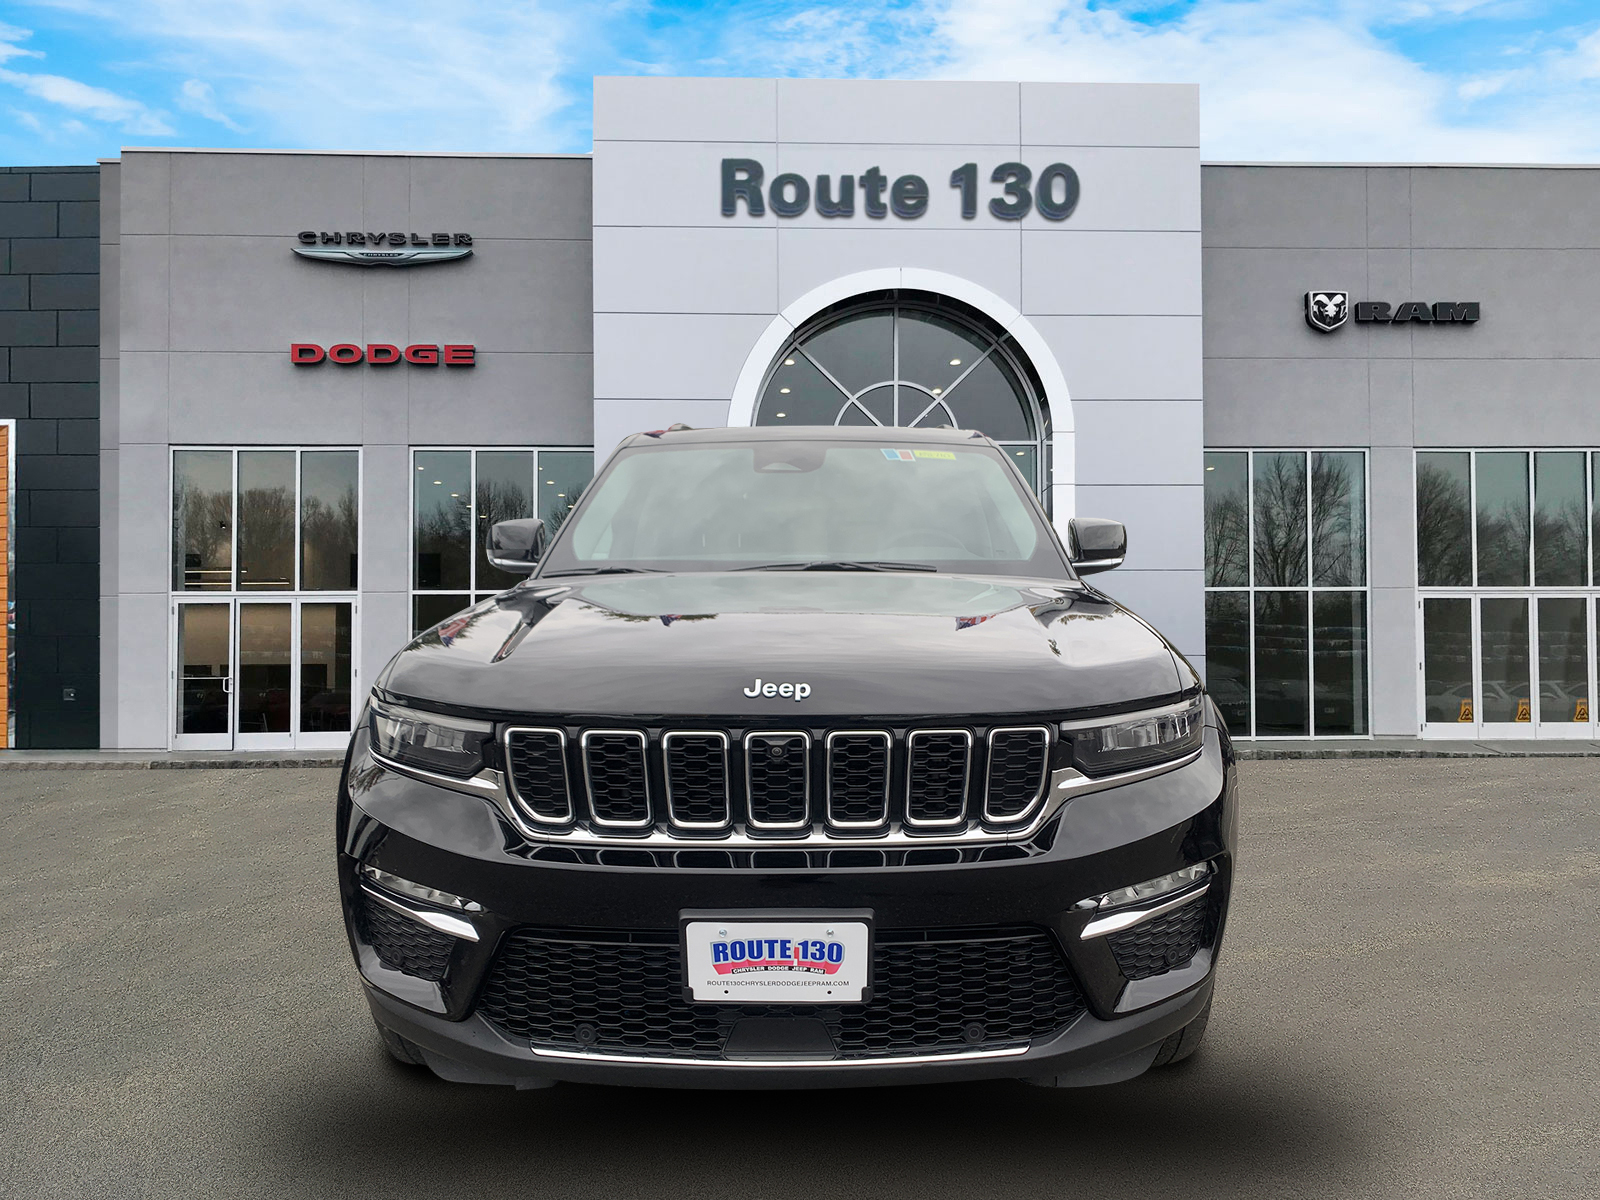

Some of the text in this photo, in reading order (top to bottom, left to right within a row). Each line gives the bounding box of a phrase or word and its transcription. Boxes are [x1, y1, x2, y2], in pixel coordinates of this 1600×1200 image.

[721, 158, 1080, 220] Route 130
[298, 231, 473, 246] CHRYSLER
[1354, 301, 1480, 323] RAM
[291, 343, 475, 365] DODGE
[743, 678, 812, 702] Jeep
[712, 939, 843, 963] ROUTE 130
[733, 966, 765, 974] CHRYSLER
